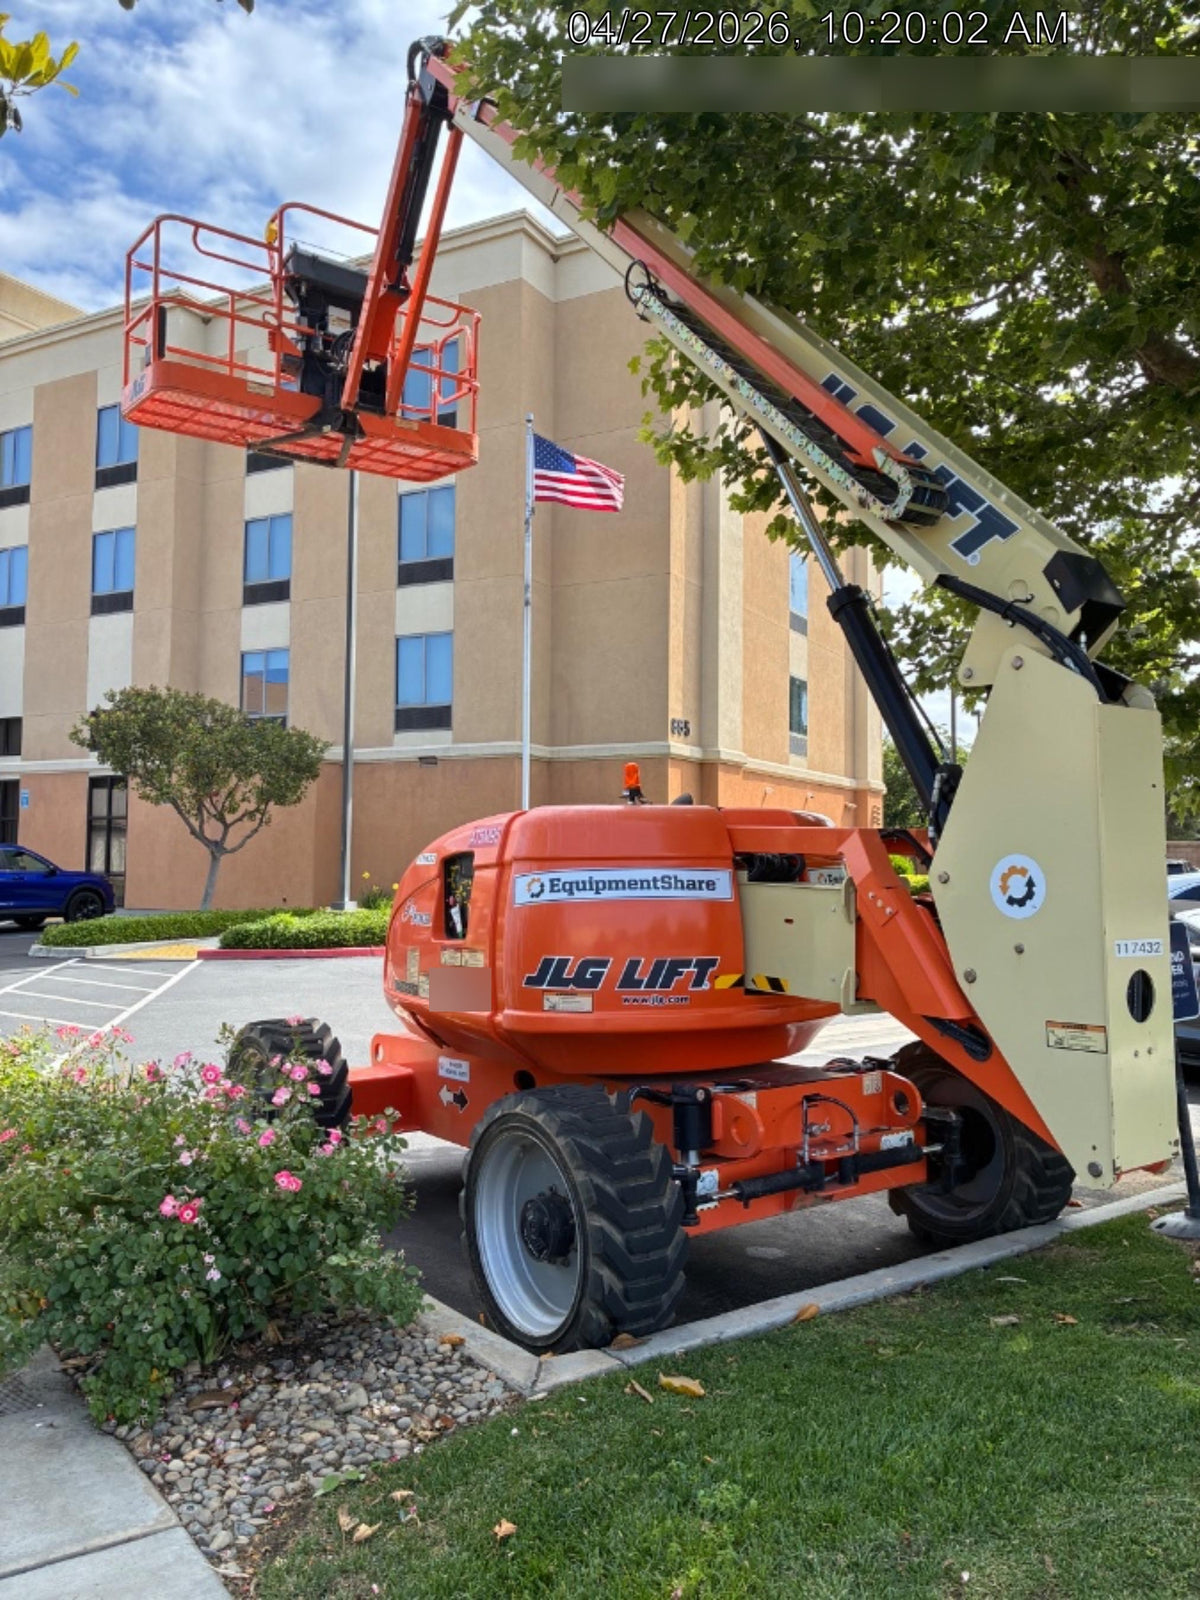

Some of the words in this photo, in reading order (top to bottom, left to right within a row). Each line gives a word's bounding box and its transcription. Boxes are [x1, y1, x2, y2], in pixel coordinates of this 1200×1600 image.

[548, 874, 717, 896] EquipmentShare
[1116, 941, 1161, 955] 117432
[522, 956, 614, 991] JLG
[615, 956, 720, 991] LIFT
